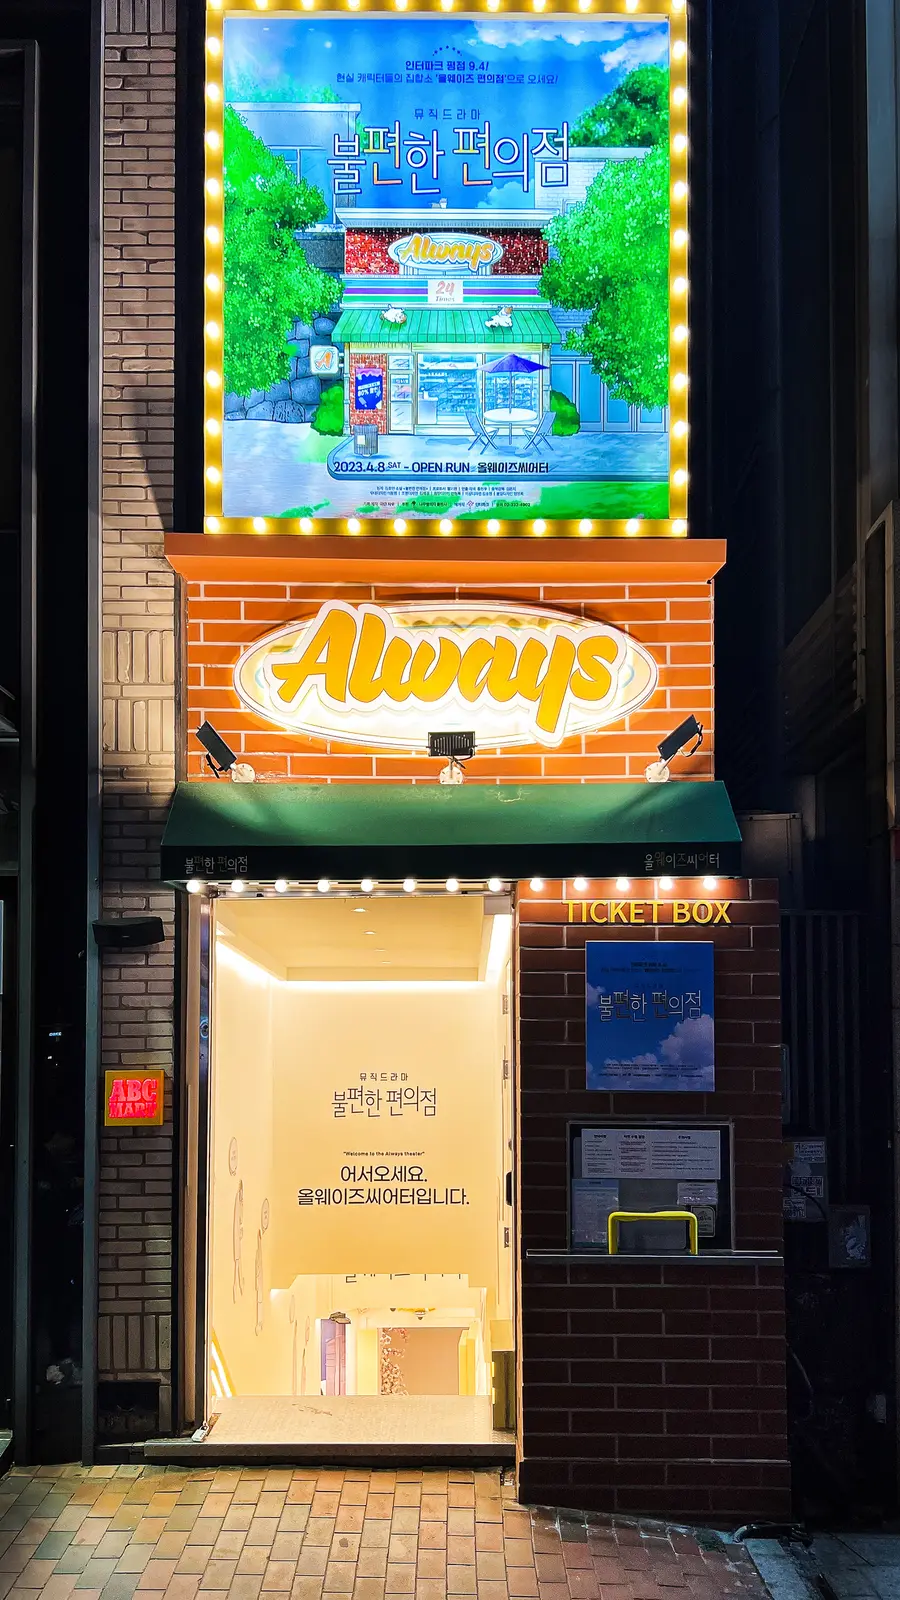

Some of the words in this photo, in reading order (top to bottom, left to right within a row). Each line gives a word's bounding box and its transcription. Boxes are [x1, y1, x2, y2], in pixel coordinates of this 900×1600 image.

[405, 60, 444, 70] 인터파크
[446, 60, 466, 71] 평점
[336, 73, 354, 83] 현실
[406, 74, 433, 84] 집합소
[327, 120, 446, 195] 불편한
[453, 120, 569, 193] 편의점
[400, 235, 493, 269] Always
[334, 461, 385, 473] 2023.4.8
[388, 461, 402, 469] SAT
[412, 462, 444, 472] OPEN
[446, 462, 470, 472] RUN
[478, 462, 549, 474] 올웨이즈씨어터
[271, 608, 619, 732] Always
[184, 855, 215, 874] 불편한
[217, 855, 248, 873] 편의점
[563, 899, 664, 924] TICKET
[672, 900, 732, 925] BOX
[598, 989, 648, 1023] 불편한
[651, 989, 701, 1020] 편의점
[360, 1072, 408, 1082] 뮤직드라마
[109, 1079, 157, 1102] ABC
[109, 1102, 157, 1118] MART
[331, 1085, 382, 1118] 불편한
[386, 1085, 437, 1117] 편의점
[340, 1166, 428, 1182] 어서오세요.
[298, 1187, 470, 1206] 올웨이즈씨어터입니다.
